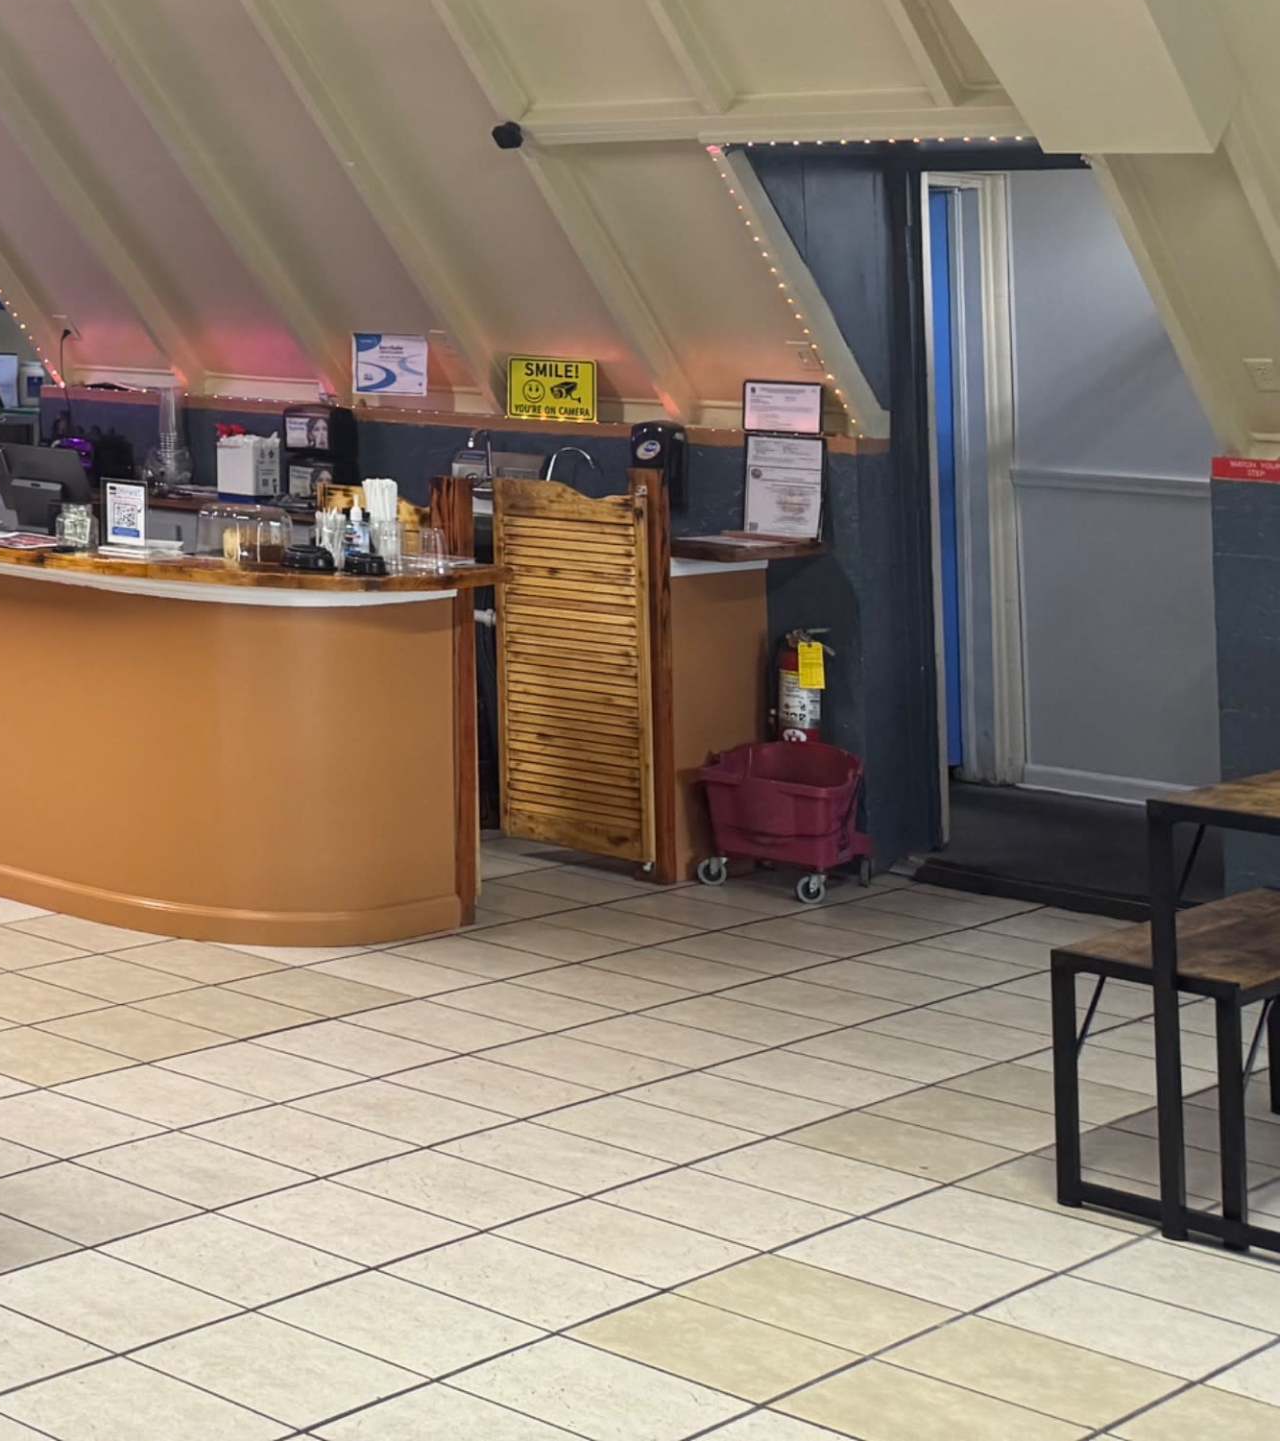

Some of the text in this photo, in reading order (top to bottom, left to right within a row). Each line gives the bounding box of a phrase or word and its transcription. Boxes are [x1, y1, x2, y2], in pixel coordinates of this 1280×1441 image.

[524, 362, 579, 379] SMILE!
[513, 403, 590, 417] YOU'RE ON CAMERA
